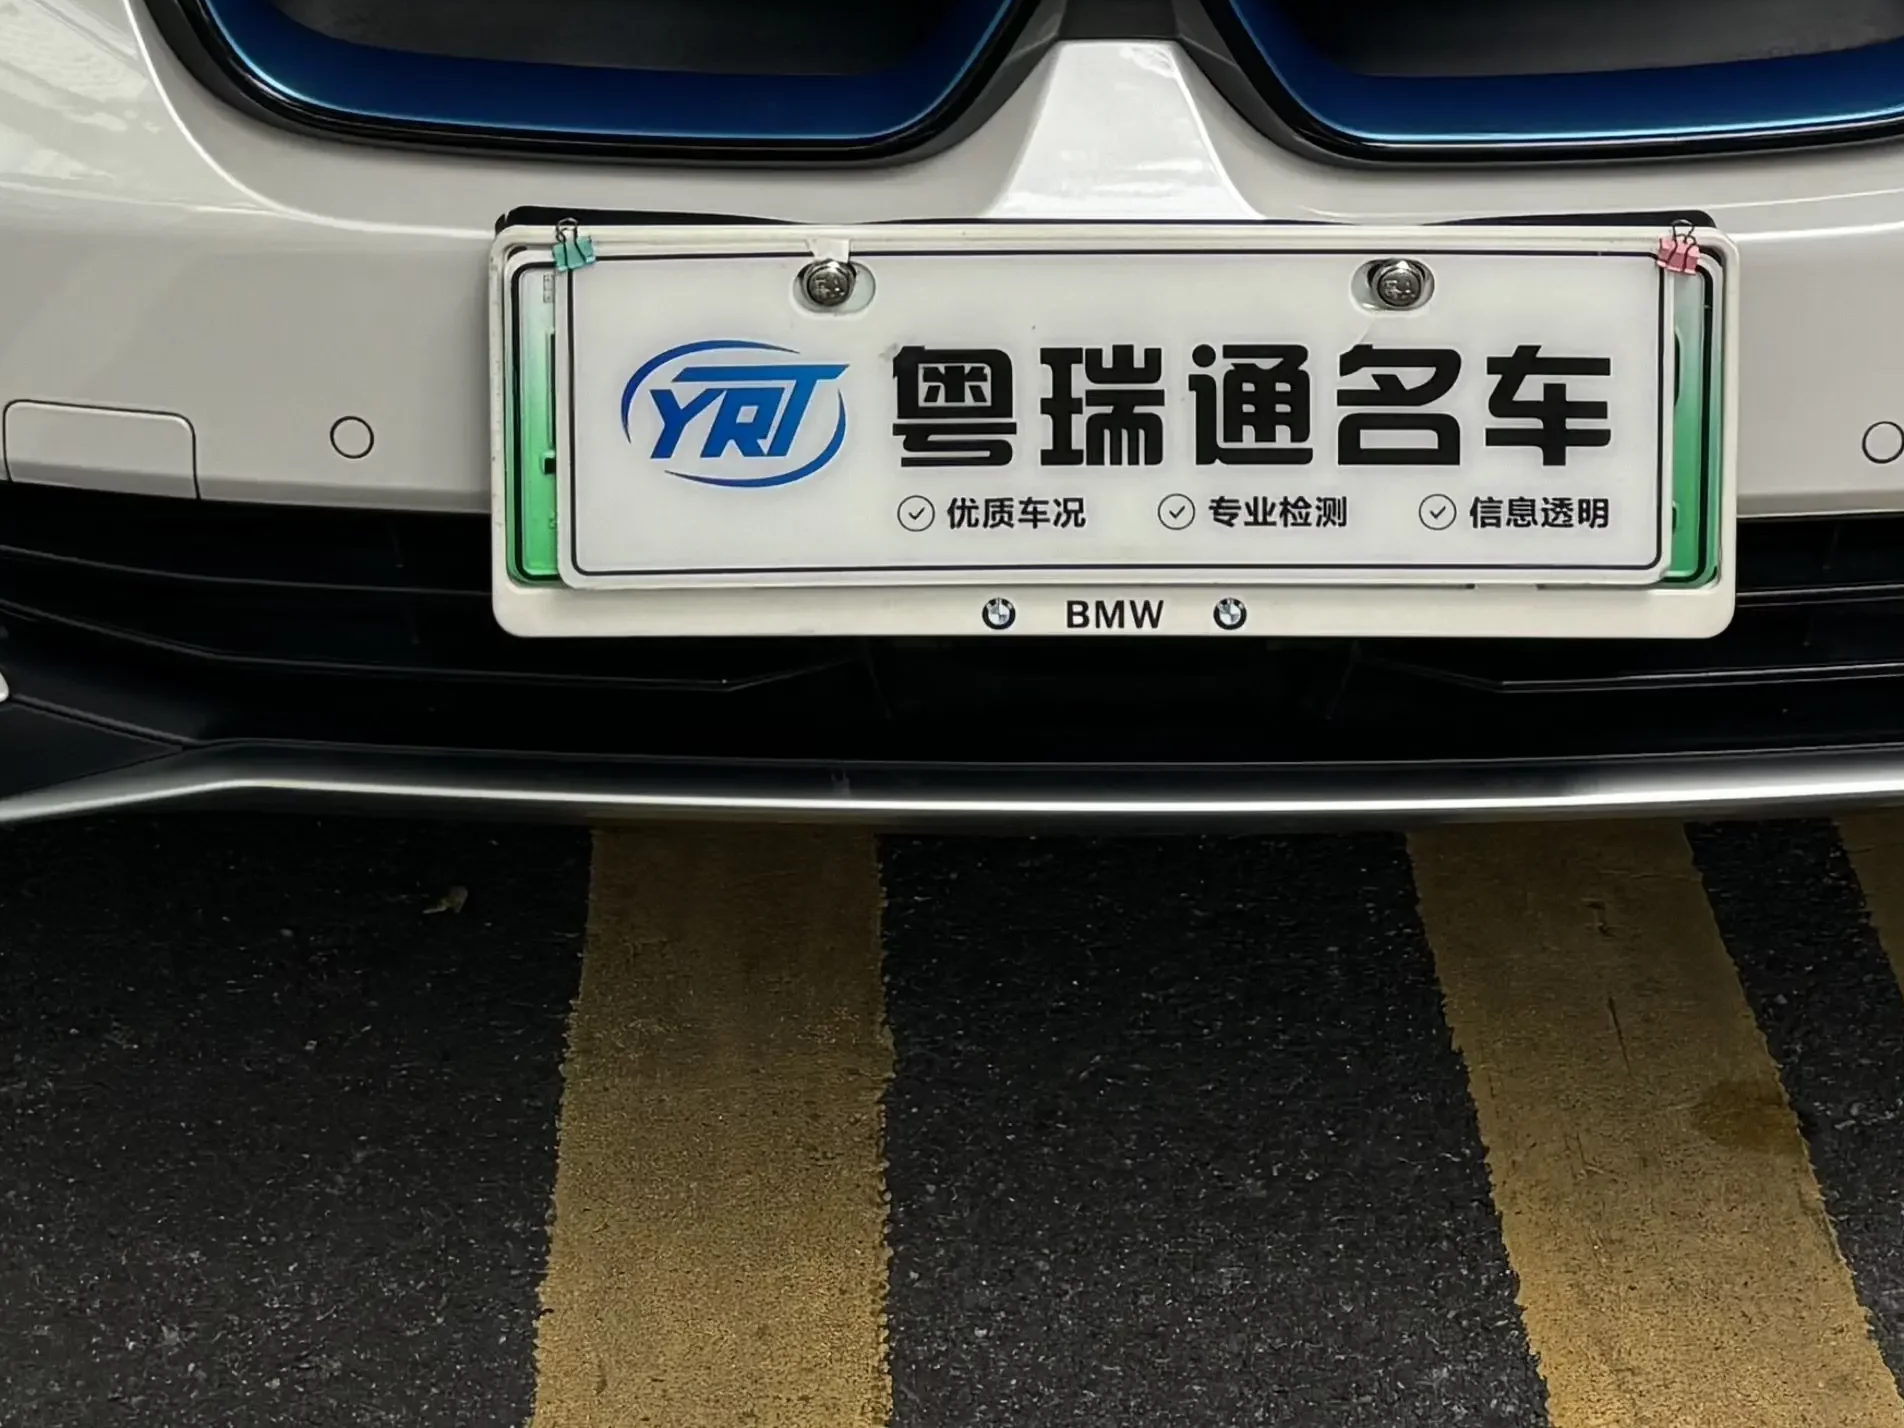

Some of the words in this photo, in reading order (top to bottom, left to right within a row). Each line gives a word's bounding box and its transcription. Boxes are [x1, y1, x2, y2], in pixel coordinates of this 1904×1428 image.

[649, 363, 851, 459] YRT
[892, 343, 1612, 467] 粤瑞通名车
[946, 496, 1087, 530] 优质车况
[1208, 495, 1347, 529] 专业检测
[1469, 495, 1610, 529] 信息透明
[1066, 599, 1164, 629] BMW
